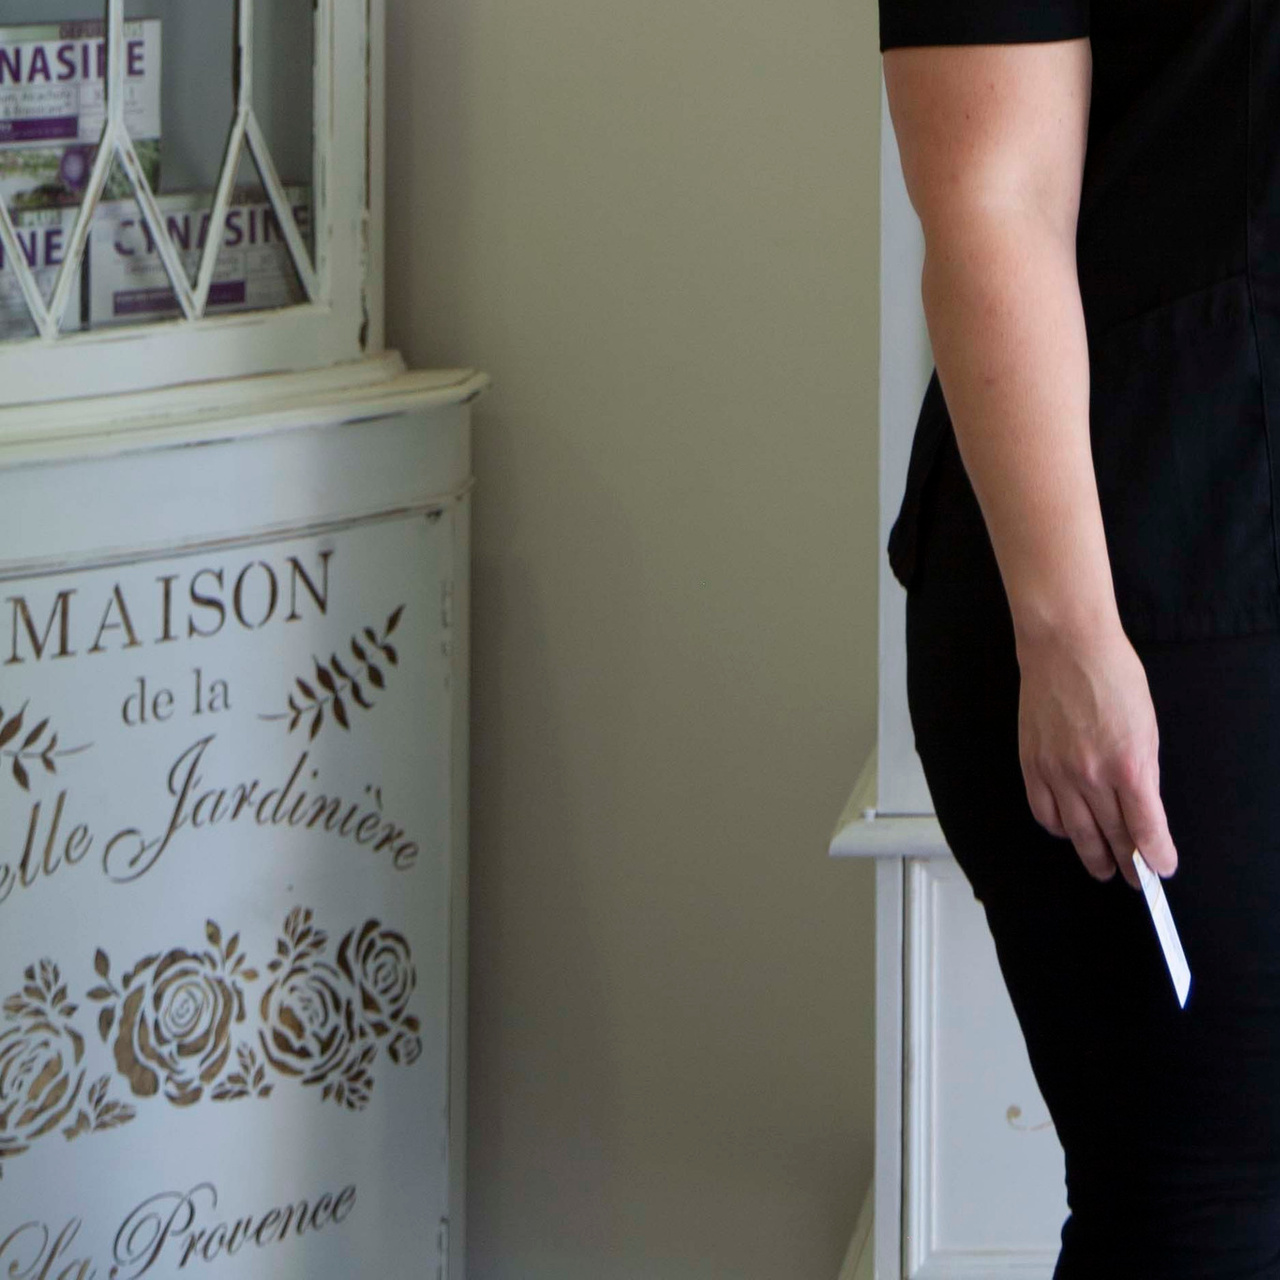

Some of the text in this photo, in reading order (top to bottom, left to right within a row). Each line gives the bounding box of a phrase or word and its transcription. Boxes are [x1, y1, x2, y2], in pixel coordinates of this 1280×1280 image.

[3, 550, 334, 666] MAISON
[122, 668, 231, 727] de la
[102, 734, 420, 885] Jardinière
[107, 1182, 357, 1280] Provence
